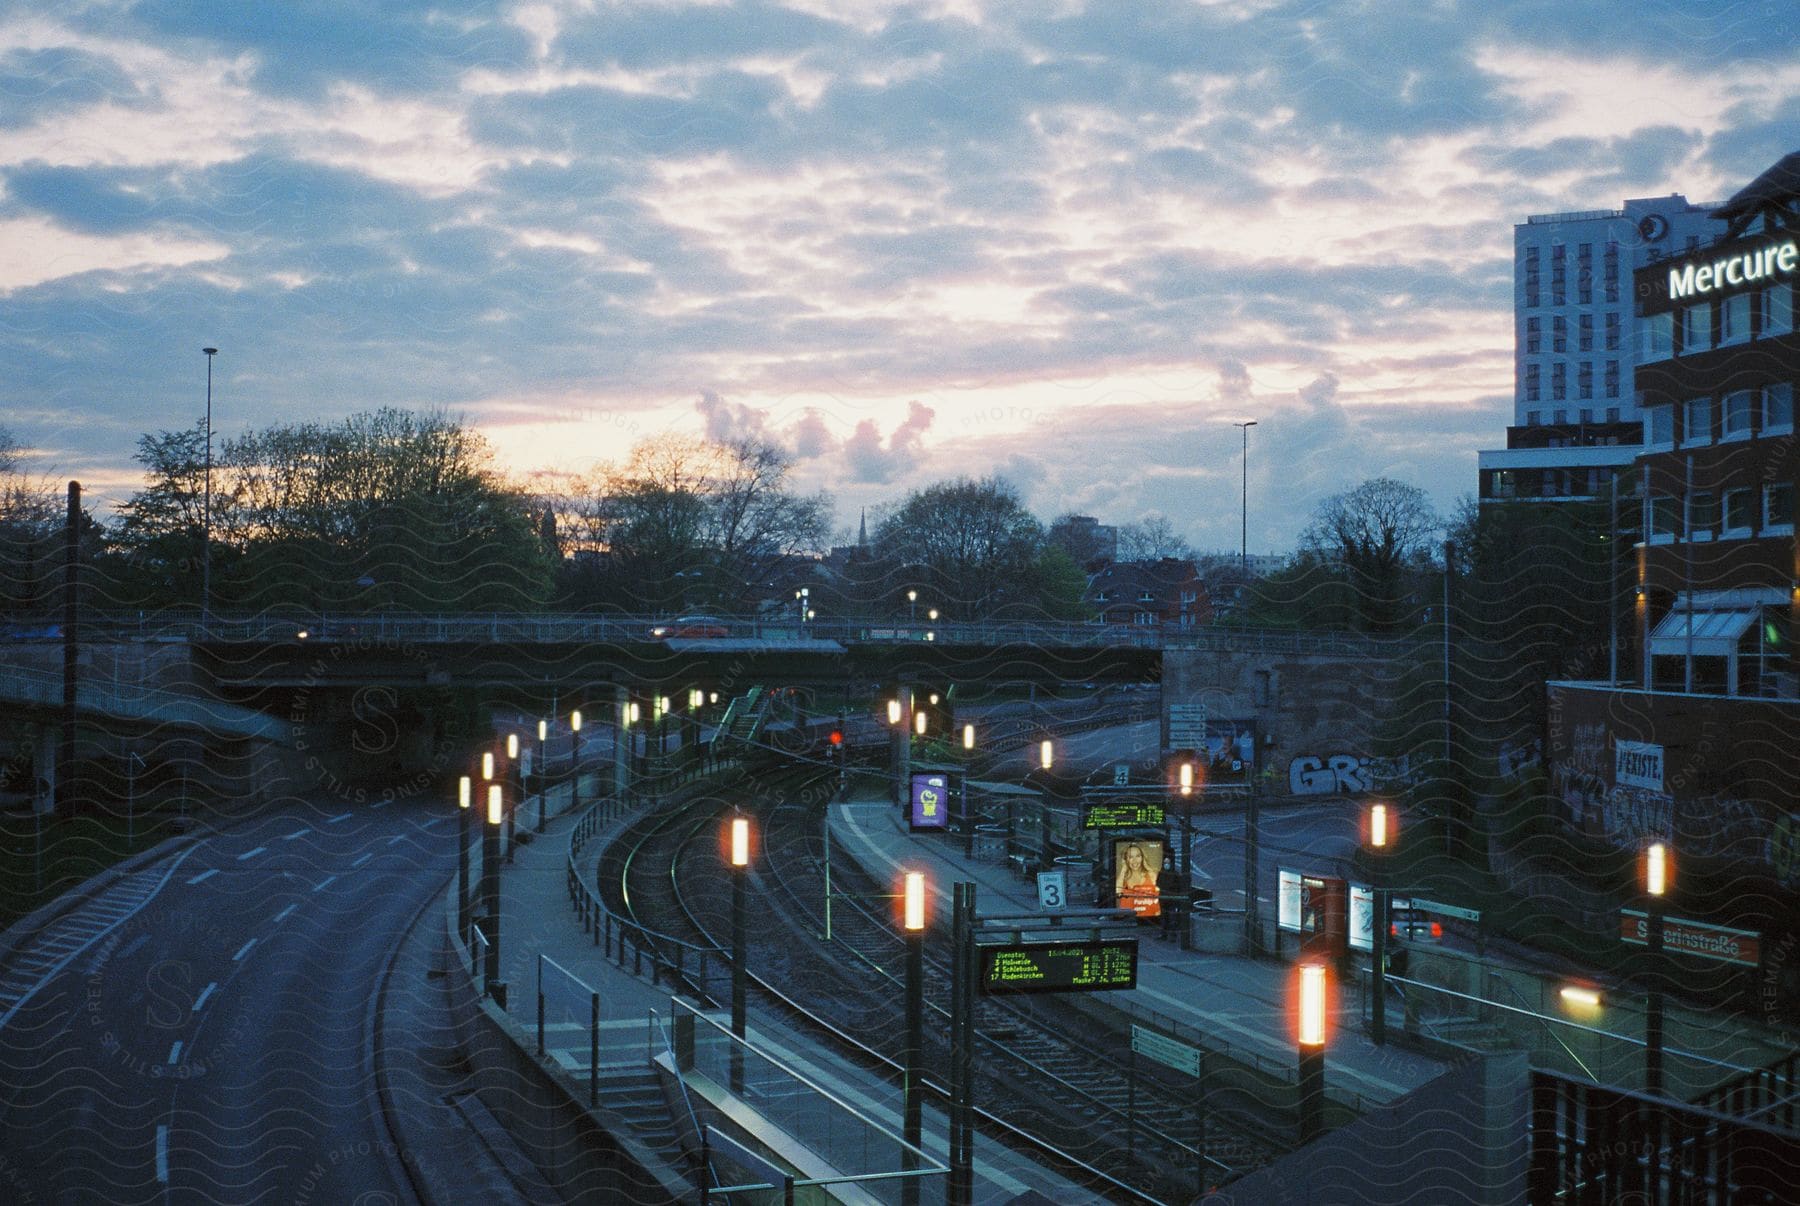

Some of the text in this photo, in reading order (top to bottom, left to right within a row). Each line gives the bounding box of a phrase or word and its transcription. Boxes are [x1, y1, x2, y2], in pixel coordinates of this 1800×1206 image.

[1669, 241, 1798, 300] Mercure
[1045, 885, 1060, 906] 3
[1637, 920, 1739, 956] Serinstraße
[991, 973, 999, 981] 17
